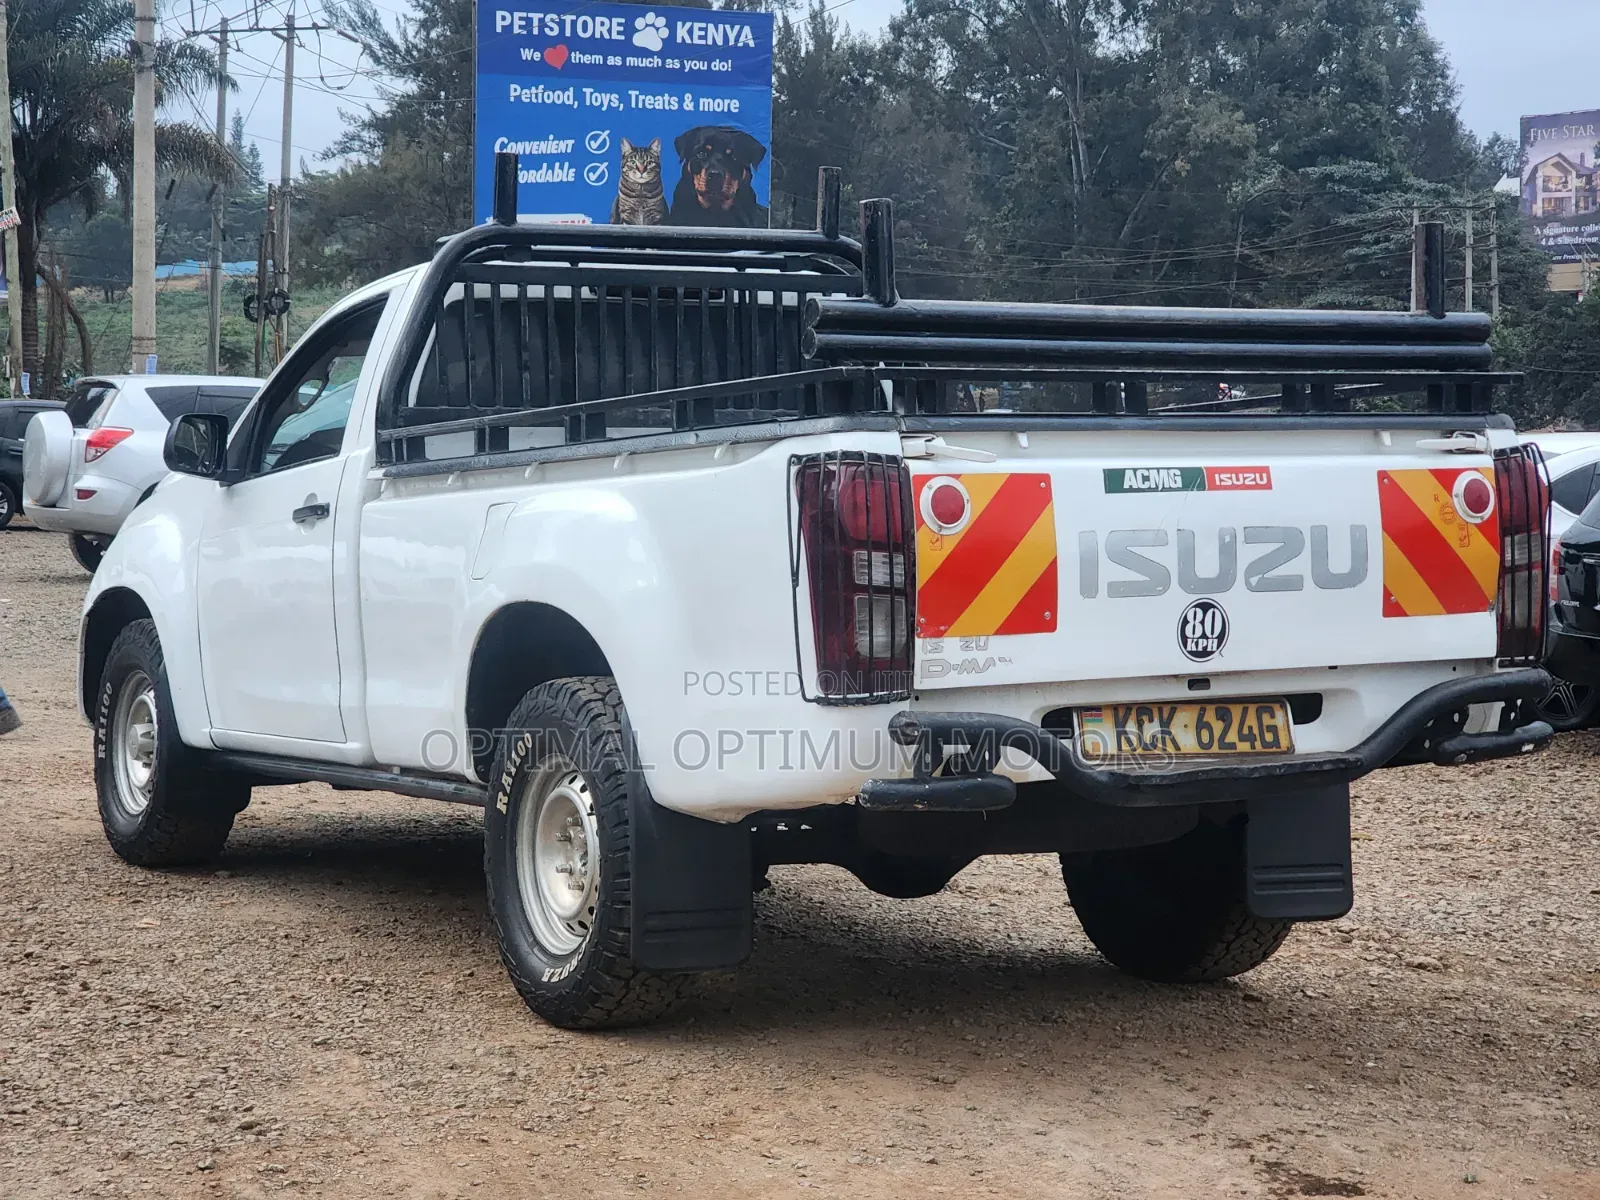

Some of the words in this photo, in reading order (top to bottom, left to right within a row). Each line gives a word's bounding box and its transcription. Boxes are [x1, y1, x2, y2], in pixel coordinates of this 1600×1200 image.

[495, 10, 626, 41] PETSTORE
[676, 21, 755, 48] KENYA
[520, 47, 541, 62] We
[570, 51, 603, 65] them
[606, 55, 622, 66] as
[626, 55, 662, 68] much
[665, 58, 680, 69] as
[683, 59, 708, 72] you
[711, 59, 732, 71] do!
[509, 83, 579, 109] Petfood,
[582, 87, 624, 111] Toys,
[628, 90, 679, 110] Treats
[683, 93, 694, 111] &
[699, 97, 740, 113] more
[1530, 127, 1558, 141] FIVE
[1562, 124, 1595, 139] STAR
[1123, 468, 1182, 491] ACMG
[1215, 473, 1268, 486] ISUZU
[1078, 524, 1368, 599] ISUZU
[1185, 607, 1223, 639] 80
[1186, 638, 1219, 652] KPH
[1113, 706, 1181, 752] KCK
[1195, 706, 1281, 750] 624G
